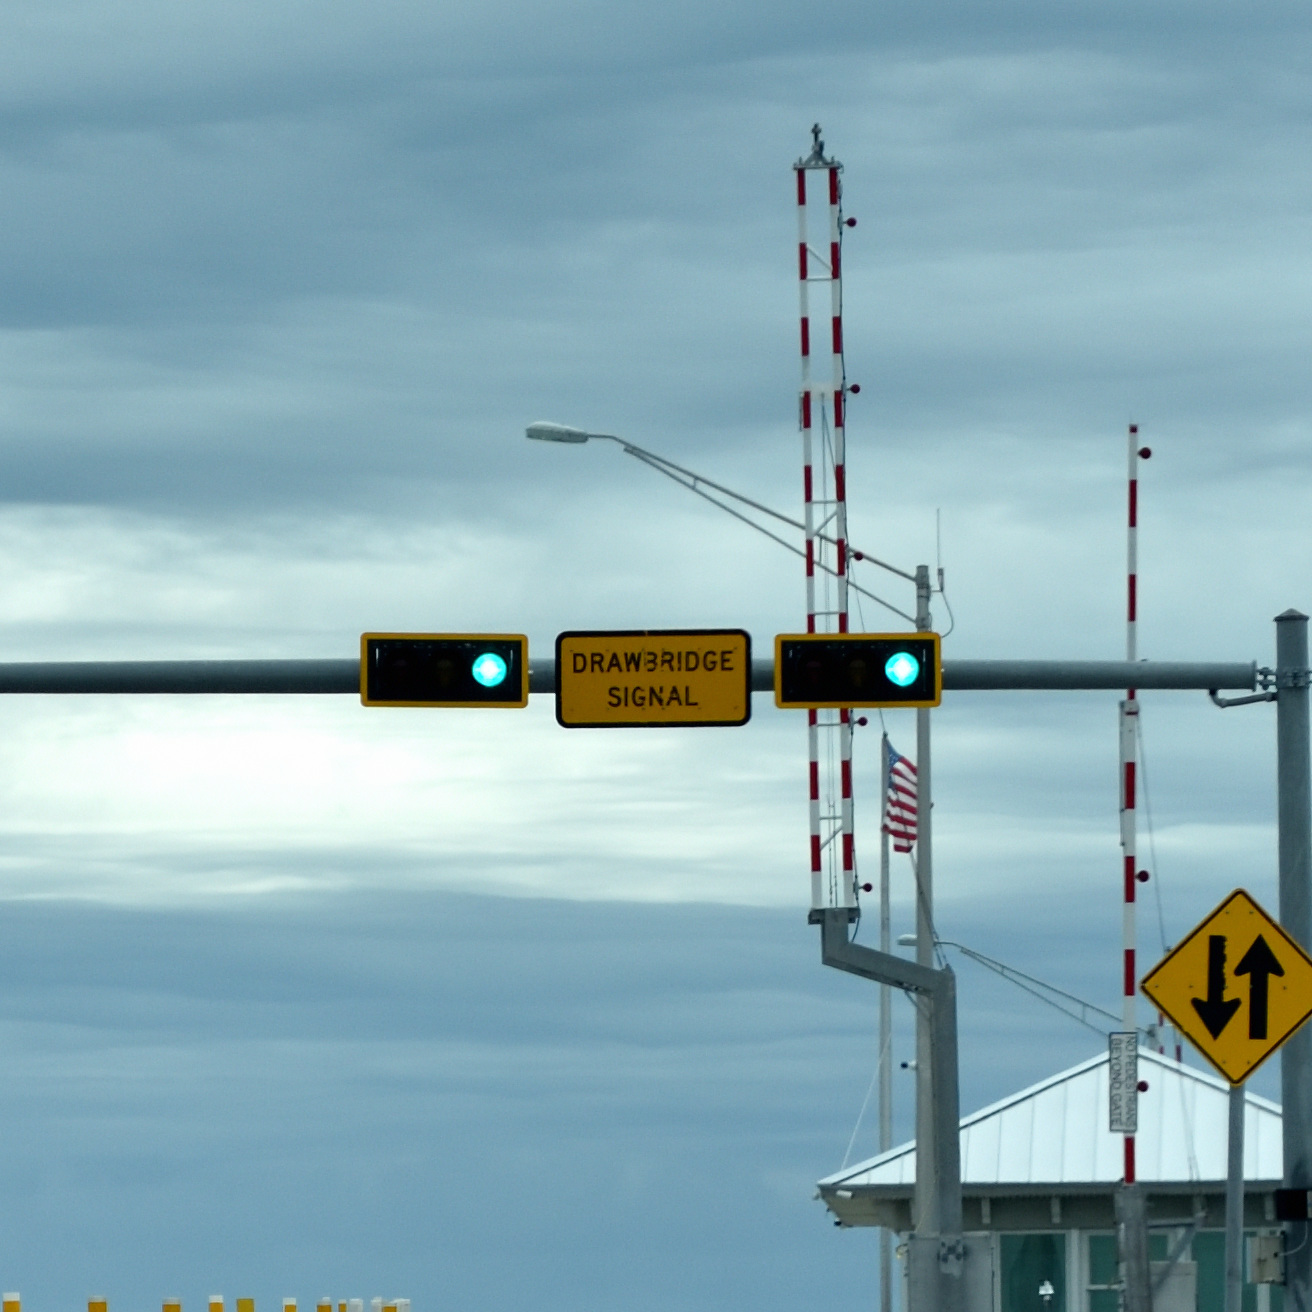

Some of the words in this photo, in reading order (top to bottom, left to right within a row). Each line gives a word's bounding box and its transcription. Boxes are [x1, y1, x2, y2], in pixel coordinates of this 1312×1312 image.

[572, 650, 734, 673] DRAWBRIDGE
[607, 686, 699, 707] SIGNAL
[1125, 1036, 1137, 1052] NO
[1111, 1038, 1122, 1090] BEYOND
[1111, 1093, 1122, 1126] GATE
